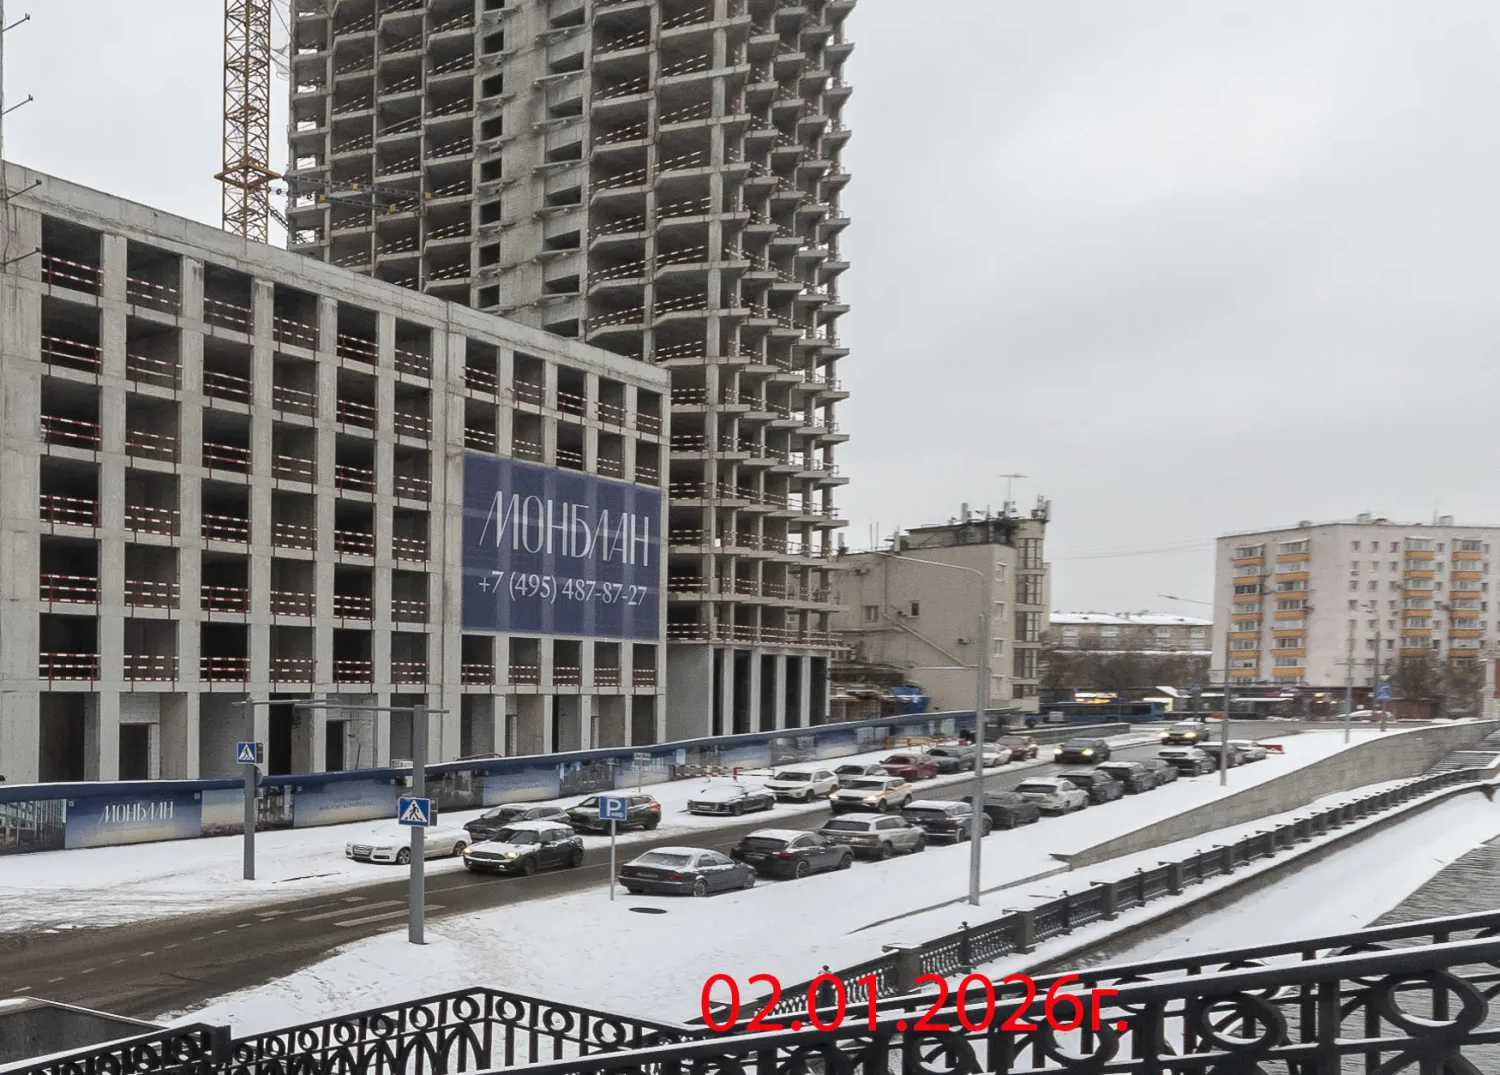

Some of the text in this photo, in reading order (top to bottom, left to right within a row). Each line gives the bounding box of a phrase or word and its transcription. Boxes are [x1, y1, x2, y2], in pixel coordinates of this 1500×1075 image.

[479, 490, 649, 566] МОНБЛАН
[478, 570, 648, 606] +7 (495) 487-87-27
[99, 801, 174, 823] МОНБЛАН
